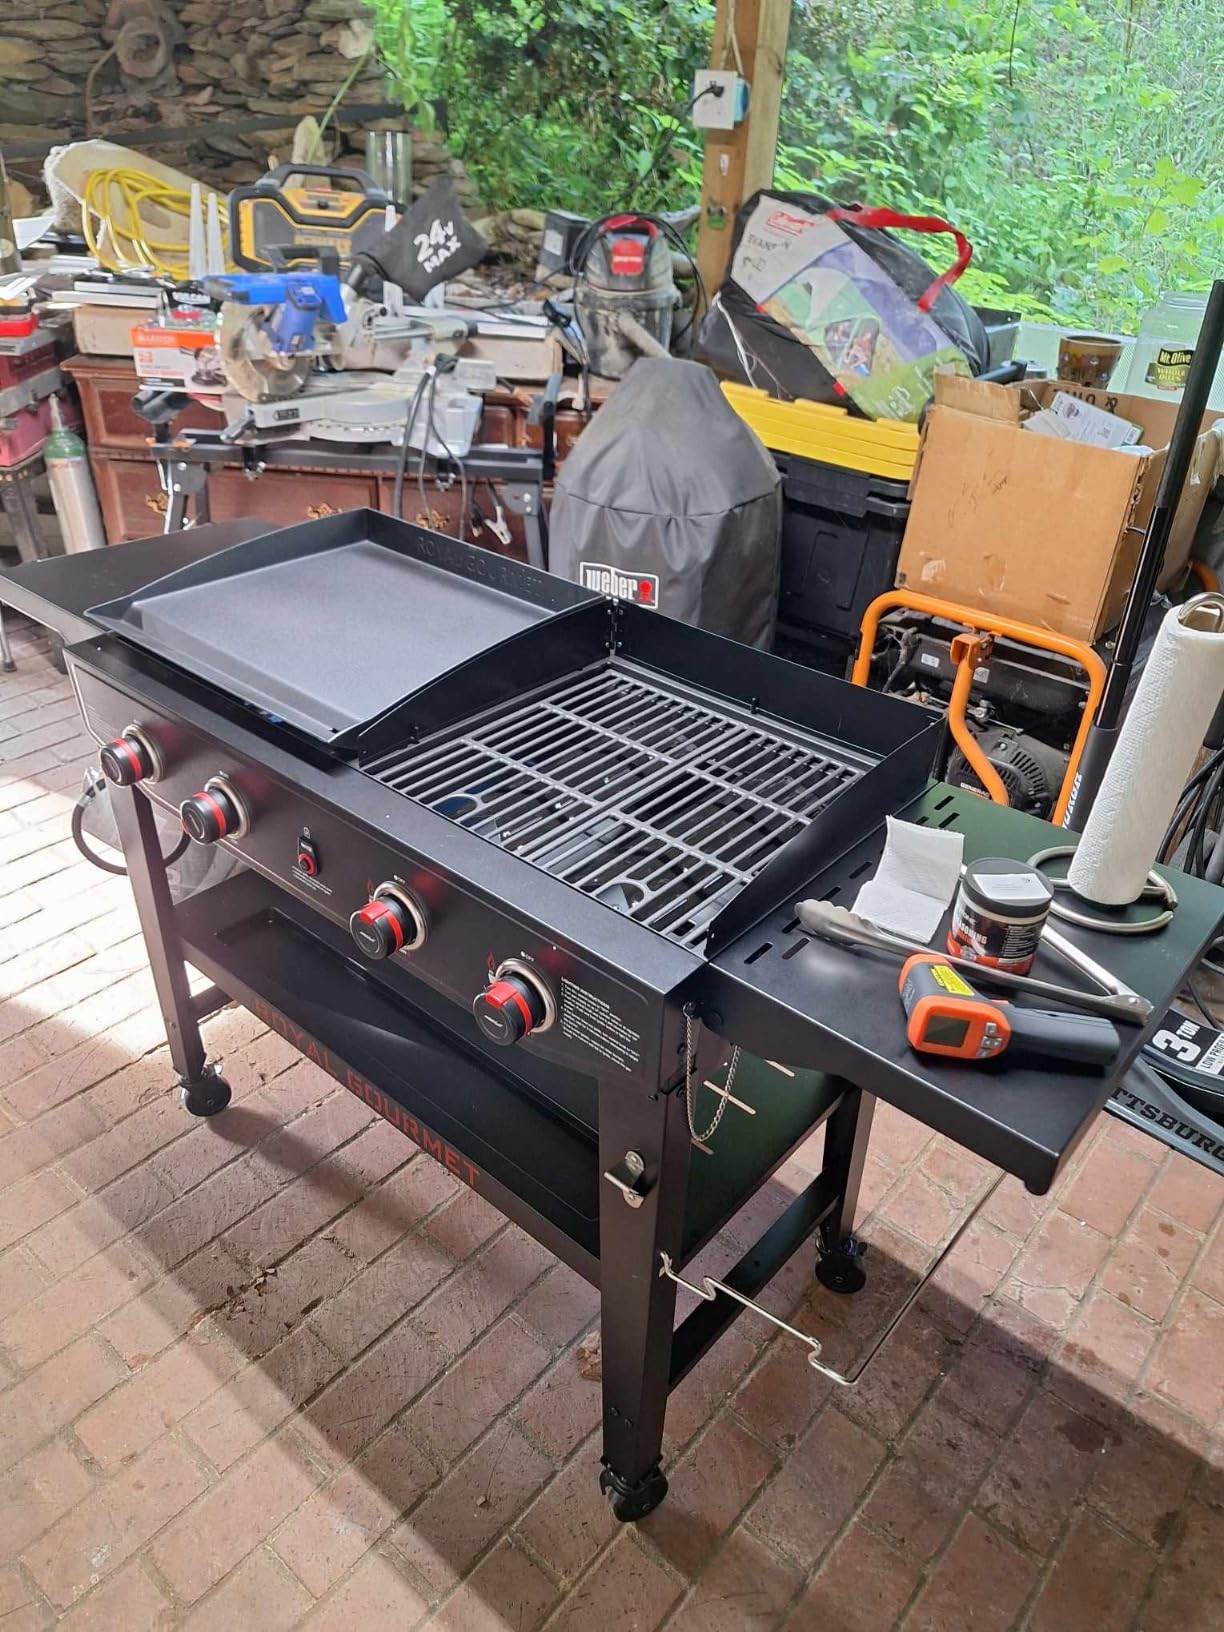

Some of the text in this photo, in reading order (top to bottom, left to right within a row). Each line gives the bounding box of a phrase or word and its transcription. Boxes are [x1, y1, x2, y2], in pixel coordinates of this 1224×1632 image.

[423, 234, 461, 274] MAX
[1170, 351, 1192, 364] Olive
[585, 567, 638, 601] weber
[1152, 1020, 1201, 1062] 3 TON
[1200, 1055, 1216, 1069] LOW
[256, 1002, 480, 1187] ROYAL GOURMET
